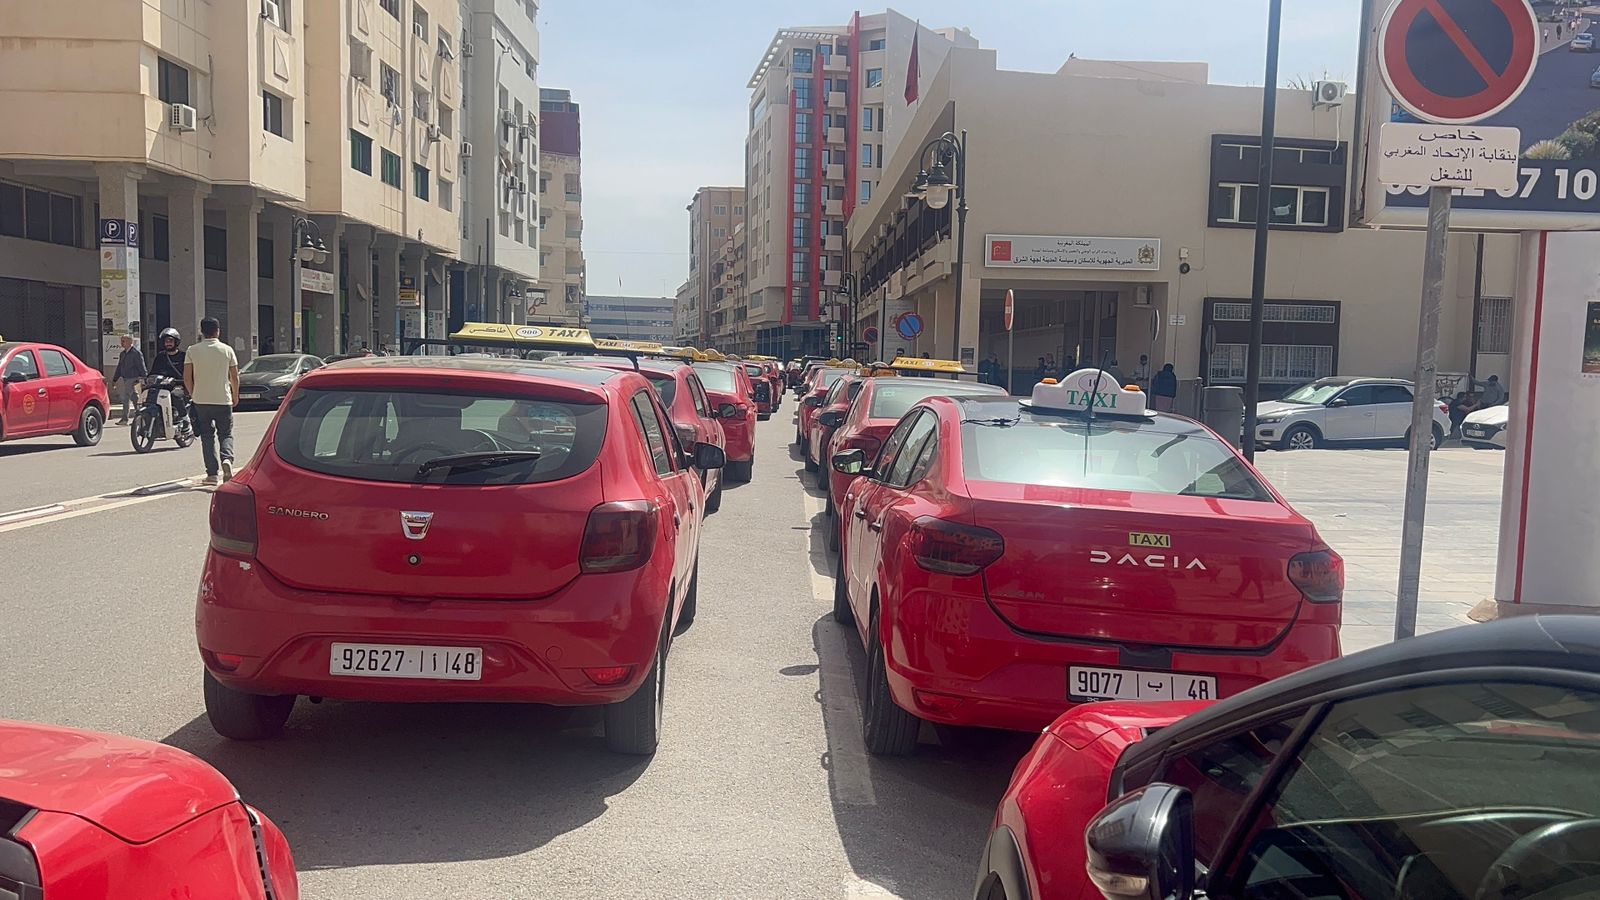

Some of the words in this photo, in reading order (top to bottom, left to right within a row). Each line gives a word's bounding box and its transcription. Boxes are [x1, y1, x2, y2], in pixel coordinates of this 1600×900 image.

[1418, 129, 1483, 142] خاص
[1384, 145, 1426, 158] المغربي
[1432, 146, 1475, 162] الإتحاد
[1478, 147, 1517, 164] بنقابة
[1430, 167, 1472, 182] للشغل
[1555, 168, 1597, 200] 10
[108, 222, 117, 235] P
[129, 226, 135, 239] P
[549, 329, 581, 338] TAXI
[1066, 390, 1118, 408] TAXI
[268, 506, 329, 520] SANDERO
[1130, 533, 1169, 546] TAXI
[1090, 550, 1207, 570] DACIA
[342, 648, 405, 672] 92627
[451, 652, 475, 674] 48
[1077, 671, 1123, 695] 9077
[1147, 680, 1163, 692] ب
[1187, 679, 1209, 700] 48
